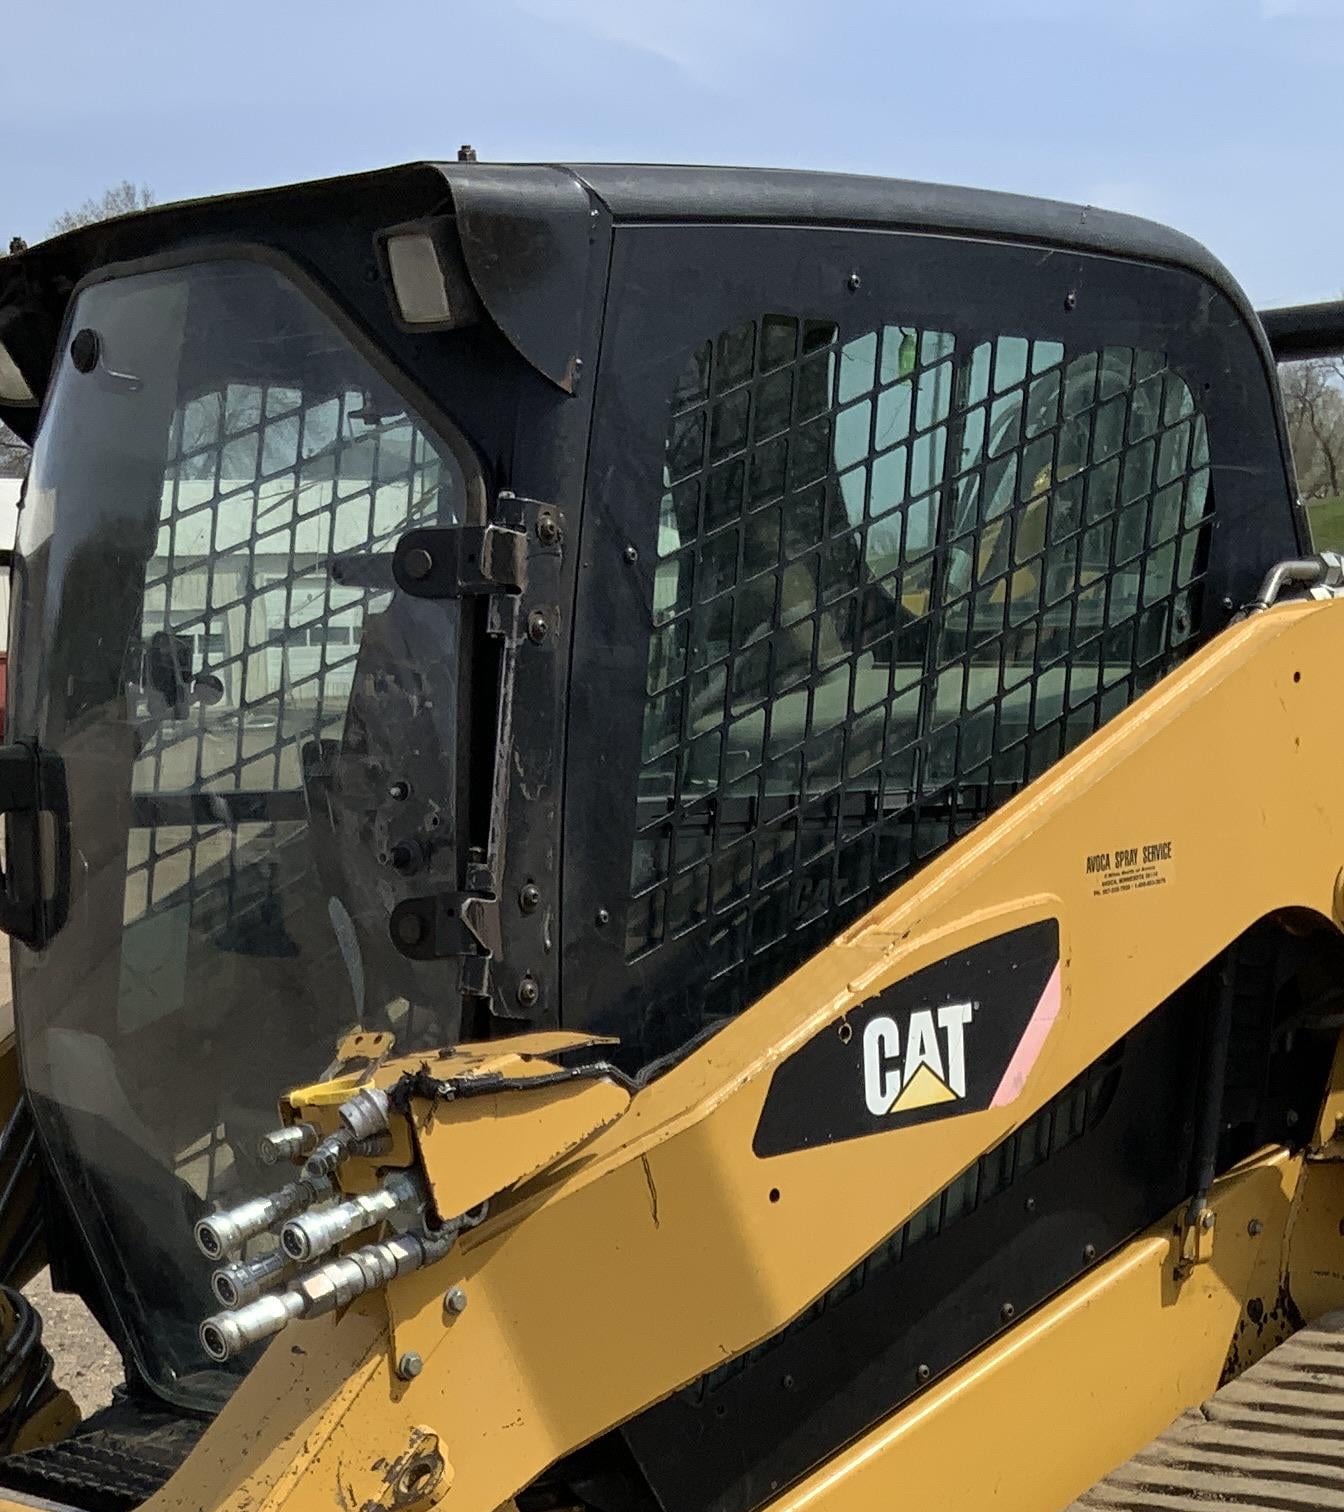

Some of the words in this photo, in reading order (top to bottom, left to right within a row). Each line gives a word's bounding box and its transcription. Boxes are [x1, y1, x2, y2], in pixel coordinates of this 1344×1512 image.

[1086, 853, 1111, 874] AVOCA
[1115, 848, 1138, 869] SPRAY
[1143, 841, 1172, 864] SERVICE
[863, 1002, 972, 1116] CAT
